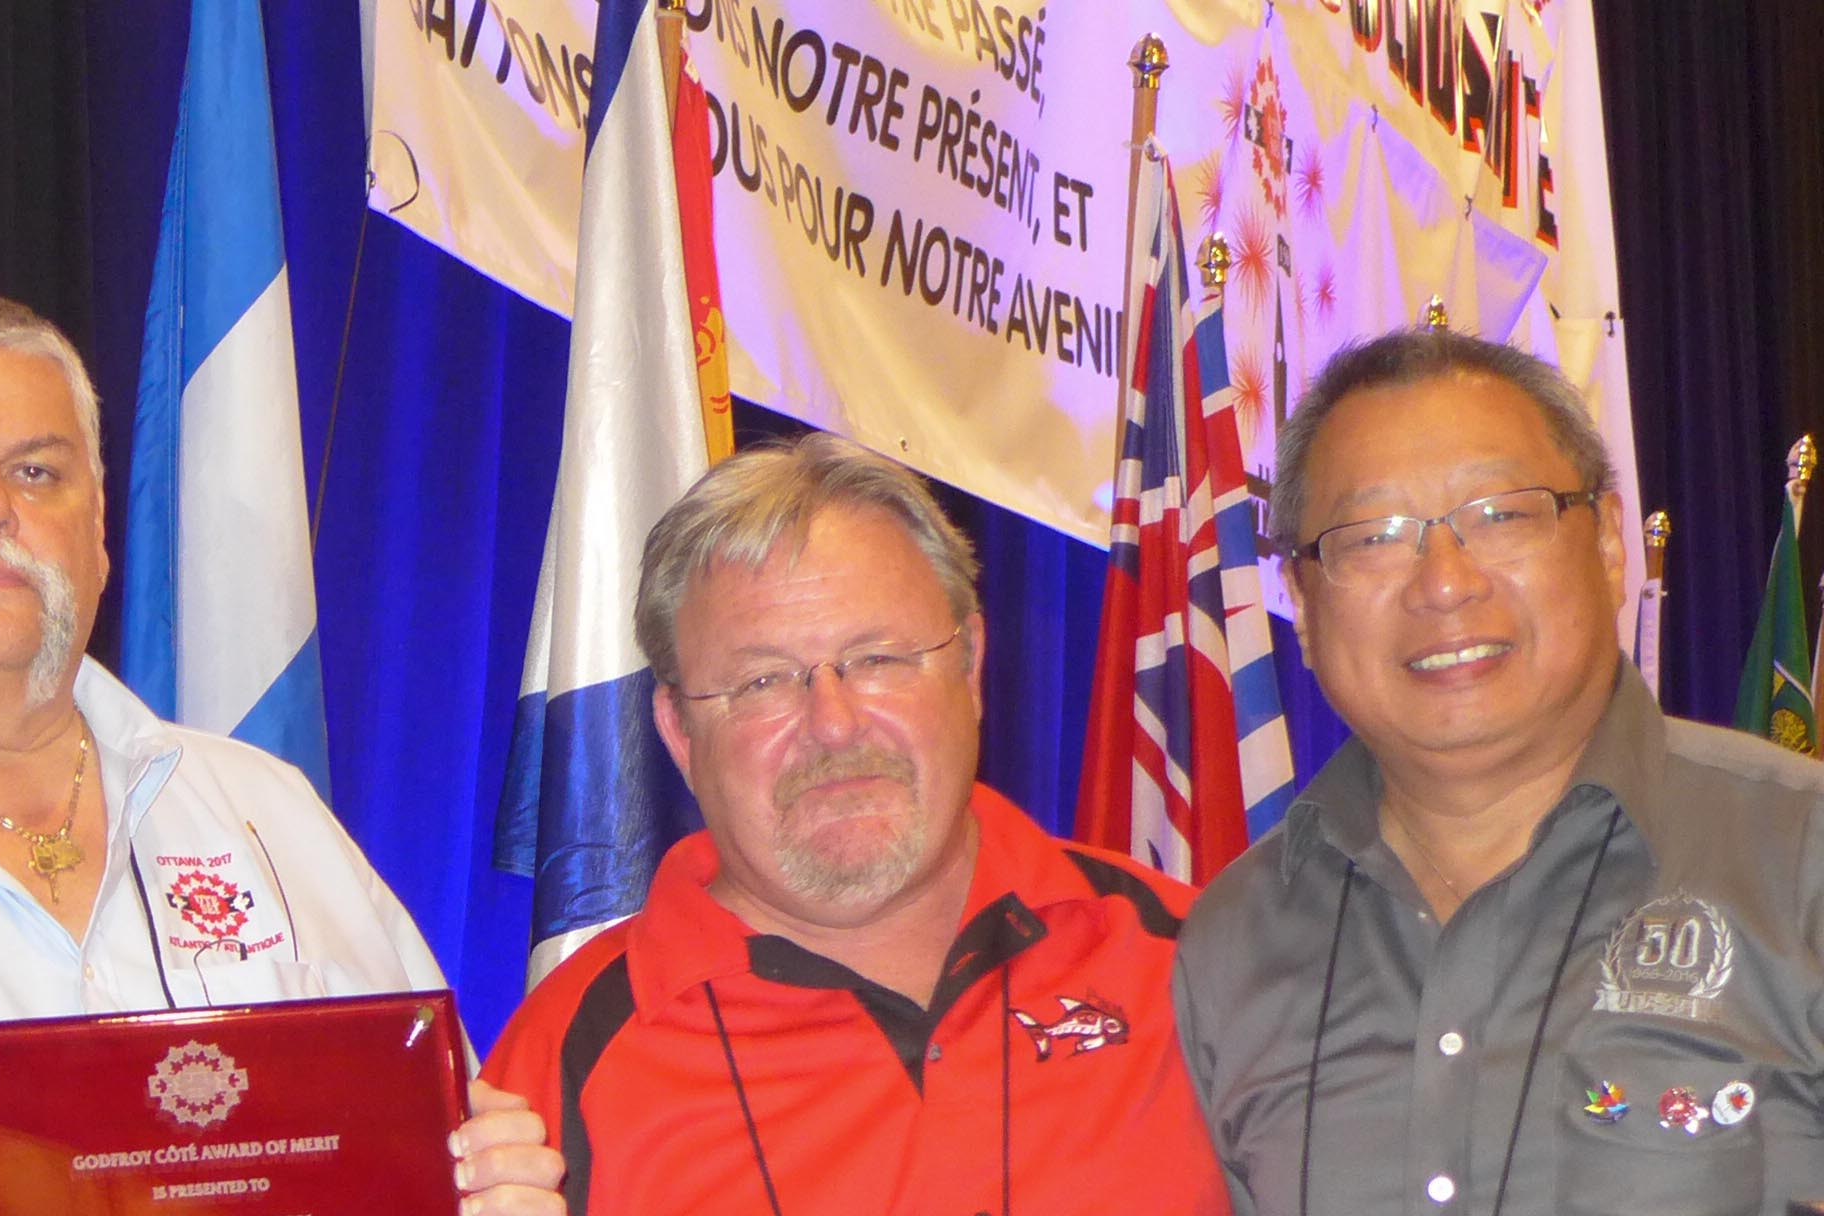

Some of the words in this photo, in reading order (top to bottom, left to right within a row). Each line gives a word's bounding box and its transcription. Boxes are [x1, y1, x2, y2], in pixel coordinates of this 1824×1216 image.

[751, 6, 910, 153] NOTRE
[913, 88, 1042, 246] PRÉSENT,
[1053, 172, 1094, 252] ET
[776, 143, 875, 278] POUR
[880, 209, 1004, 335] NOTRE
[1005, 273, 1123, 381] AVENI
[156, 855, 204, 867] OTTAWA
[207, 853, 232, 867] 2017
[1637, 917, 1700, 968] 50
[72, 1150, 152, 1170] GODFROY
[155, 1143, 199, 1164] CÔTÉ
[201, 1141, 263, 1161] AWARD
[265, 1139, 287, 1155] OF
[290, 1135, 340, 1153] MERIT
[153, 1185, 167, 1200] IS
[169, 1179, 248, 1199] PRESENTED
[249, 1178, 270, 1192] TO
